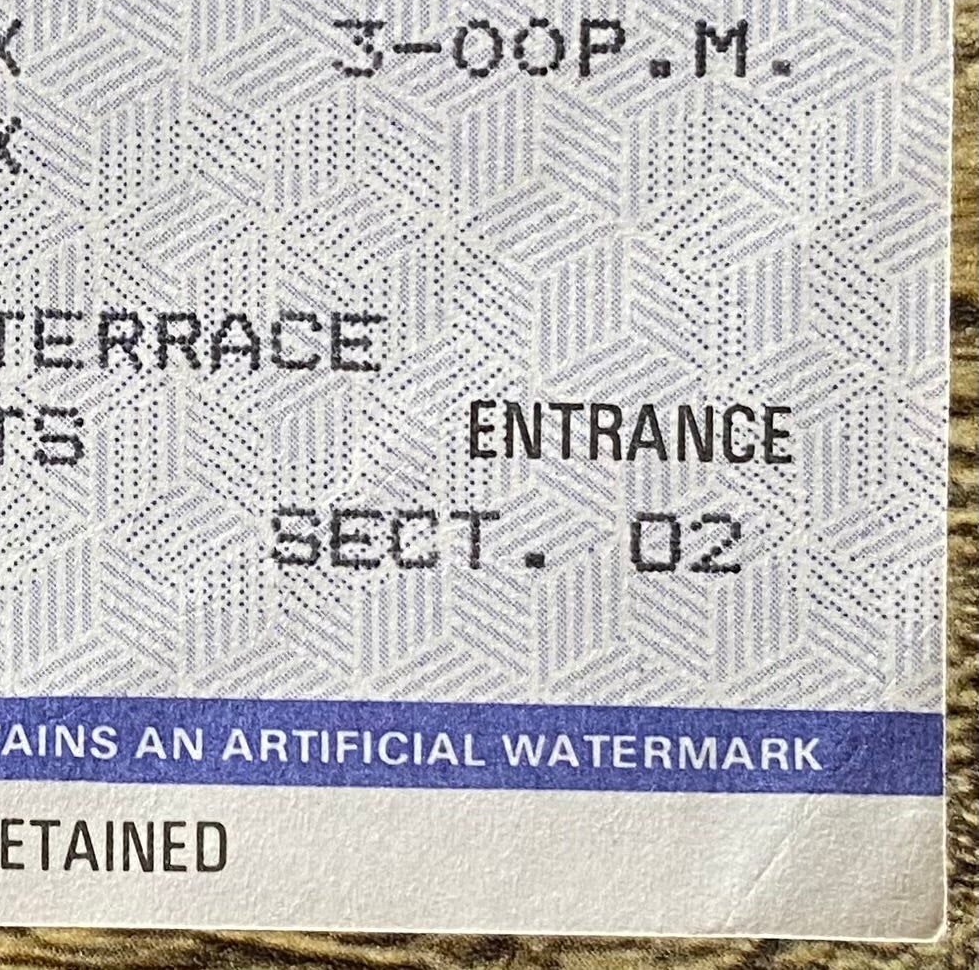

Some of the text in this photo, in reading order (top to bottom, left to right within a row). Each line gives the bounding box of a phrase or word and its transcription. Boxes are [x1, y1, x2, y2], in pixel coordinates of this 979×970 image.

[468, 400, 794, 465] ENTRANCE
[269, 507, 547, 572] SECT.
[135, 726, 205, 762] AN
[225, 728, 485, 767] ARTIFICIAL
[502, 733, 822, 771] WATERMARK
